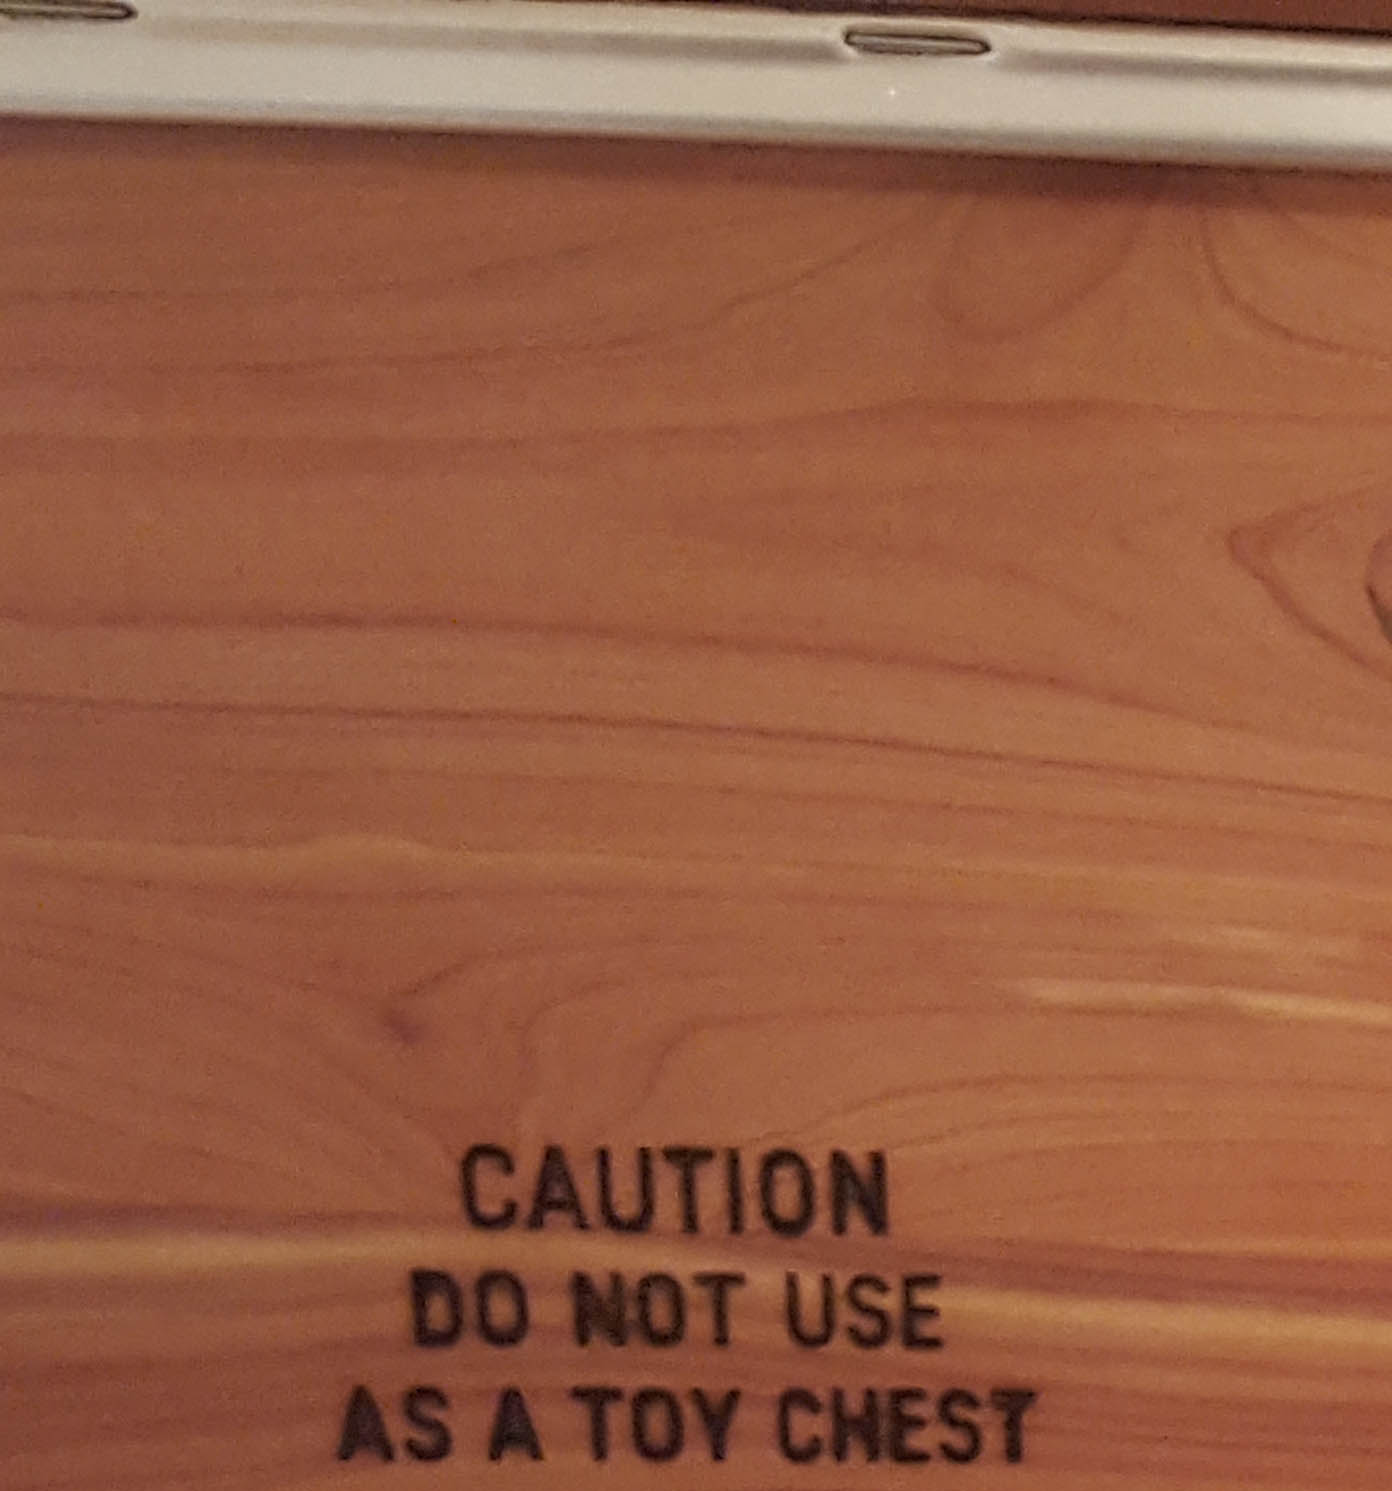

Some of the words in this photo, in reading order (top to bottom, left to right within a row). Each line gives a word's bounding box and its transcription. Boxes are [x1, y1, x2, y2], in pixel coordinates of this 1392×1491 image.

[459, 1143, 889, 1236] CAUTION
[410, 1268, 529, 1347] DO
[571, 1271, 746, 1347] NOT
[786, 1273, 944, 1350] USE
[336, 1385, 453, 1462] AS
[489, 1387, 543, 1461] A
[570, 1387, 741, 1462] TOY
[777, 1387, 1039, 1464] CHEST
